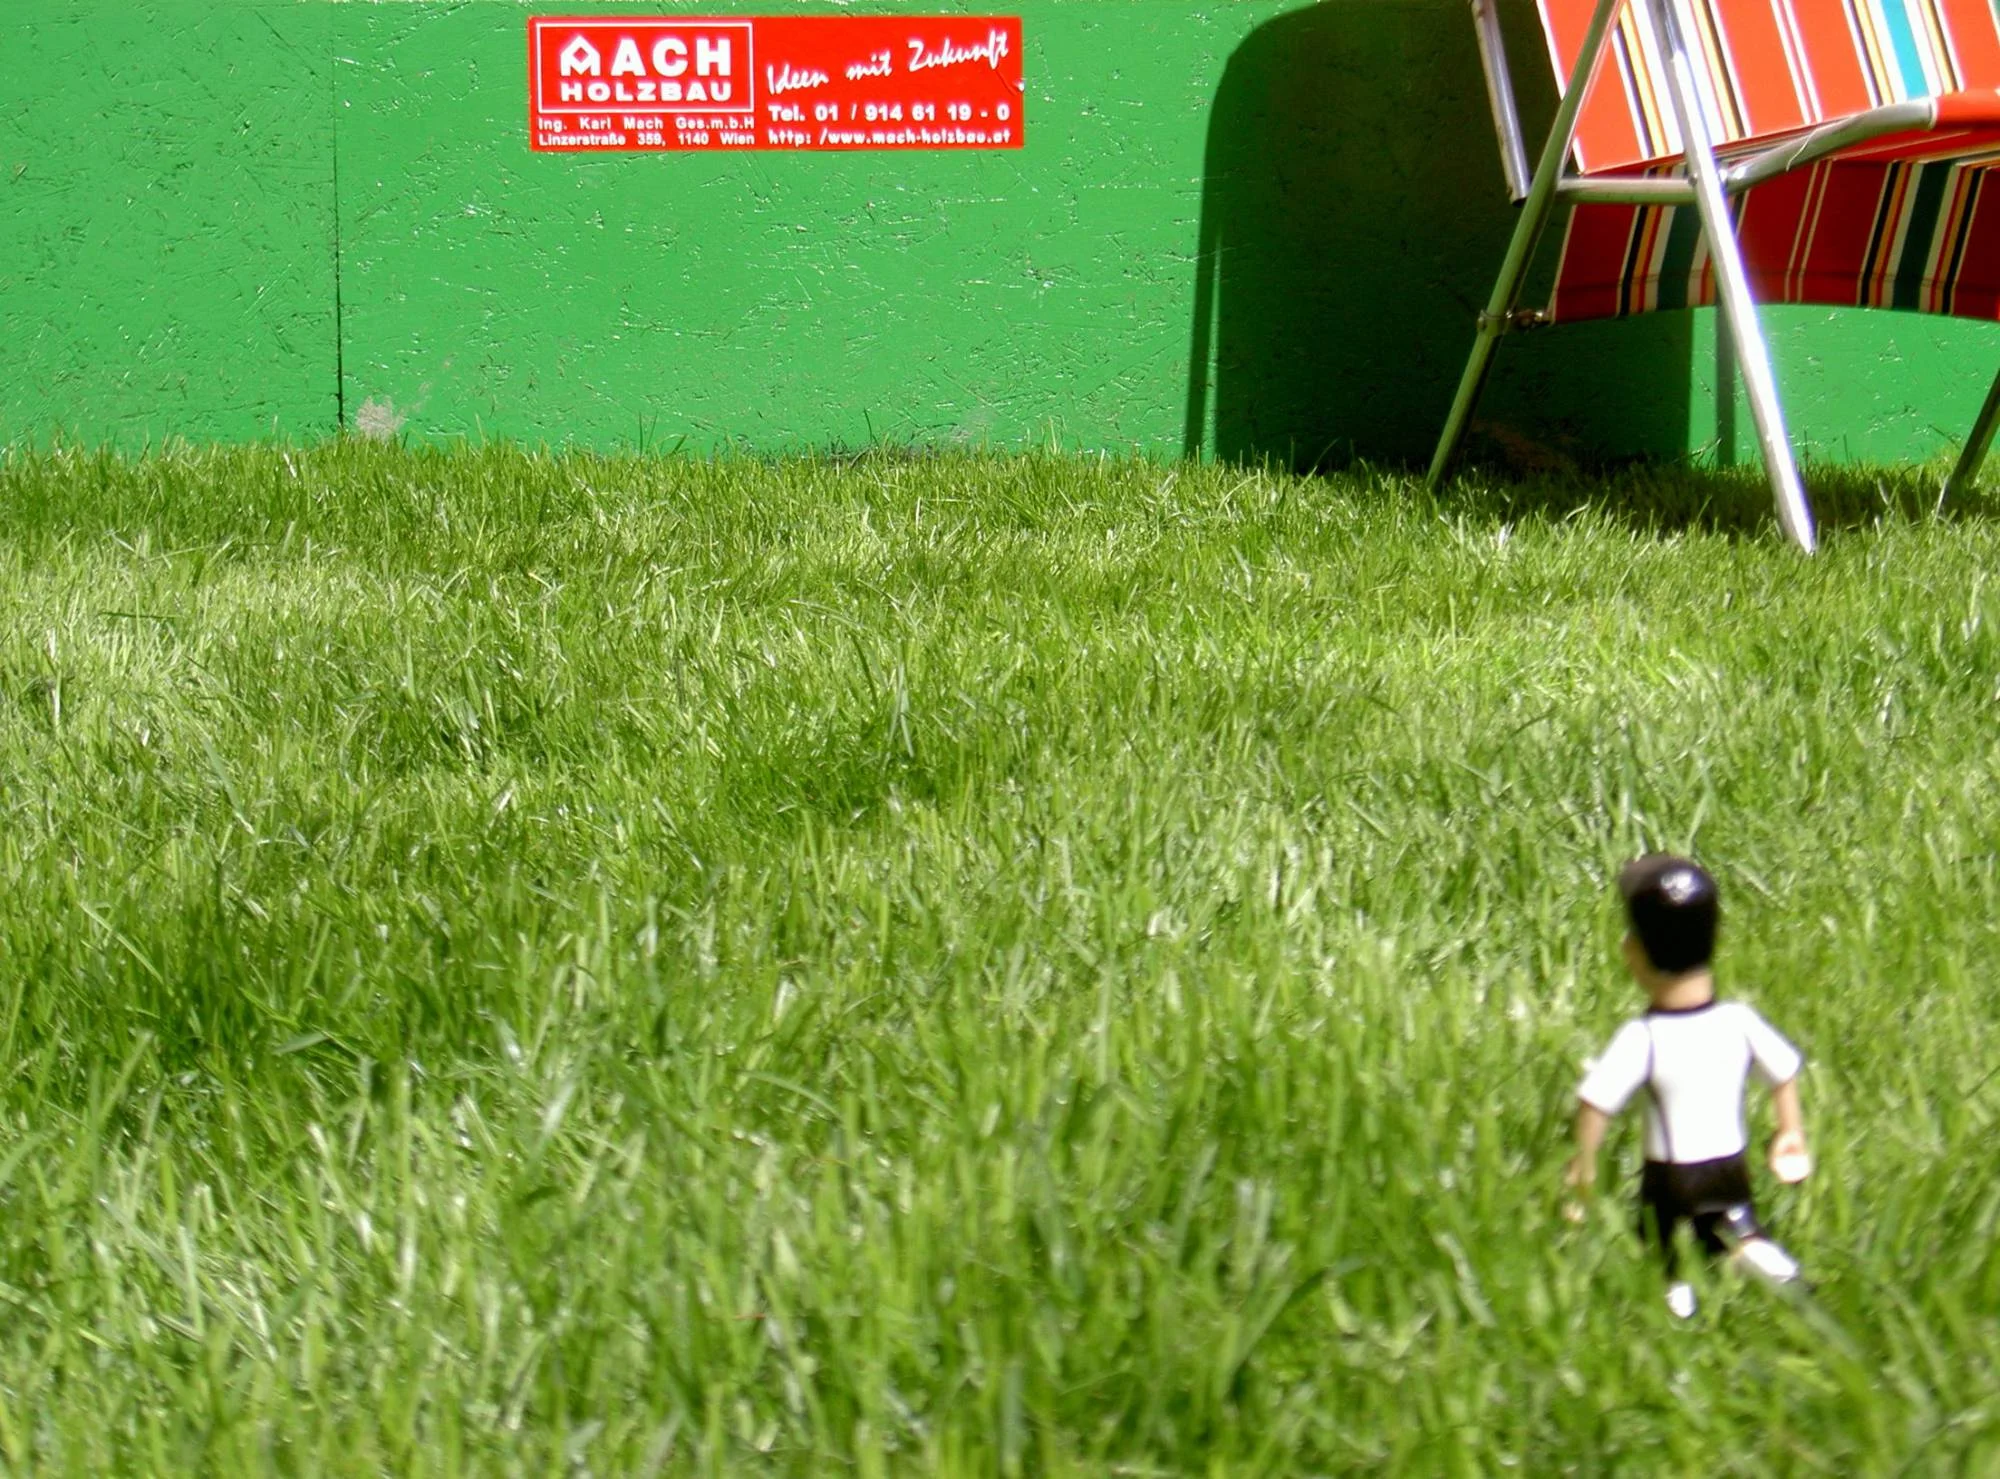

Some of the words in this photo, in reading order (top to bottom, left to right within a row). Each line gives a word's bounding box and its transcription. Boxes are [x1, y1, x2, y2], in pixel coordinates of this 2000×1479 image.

[560, 34, 731, 77] MACH
[767, 64, 829, 94] Ideen
[846, 50, 892, 80] mit
[907, 29, 1009, 73] Zukunft
[560, 81, 732, 102] HOLZBAU
[768, 103, 806, 121] Tel.
[815, 103, 839, 121] 01
[850, 103, 858, 121] /
[864, 103, 904, 121] 914
[912, 103, 936, 121] 61
[946, 103, 972, 121] 19
[996, 103, 1010, 121] 0
[538, 116, 568, 133] Ing.
[579, 115, 612, 130] Karl
[623, 115, 664, 130] Mach
[675, 115, 755, 130] Ges.m.b.H
[538, 132, 627, 146] Linzerstraße
[637, 131, 667, 147] 359,
[677, 131, 709, 145] 1140
[719, 131, 756, 145] Wien
